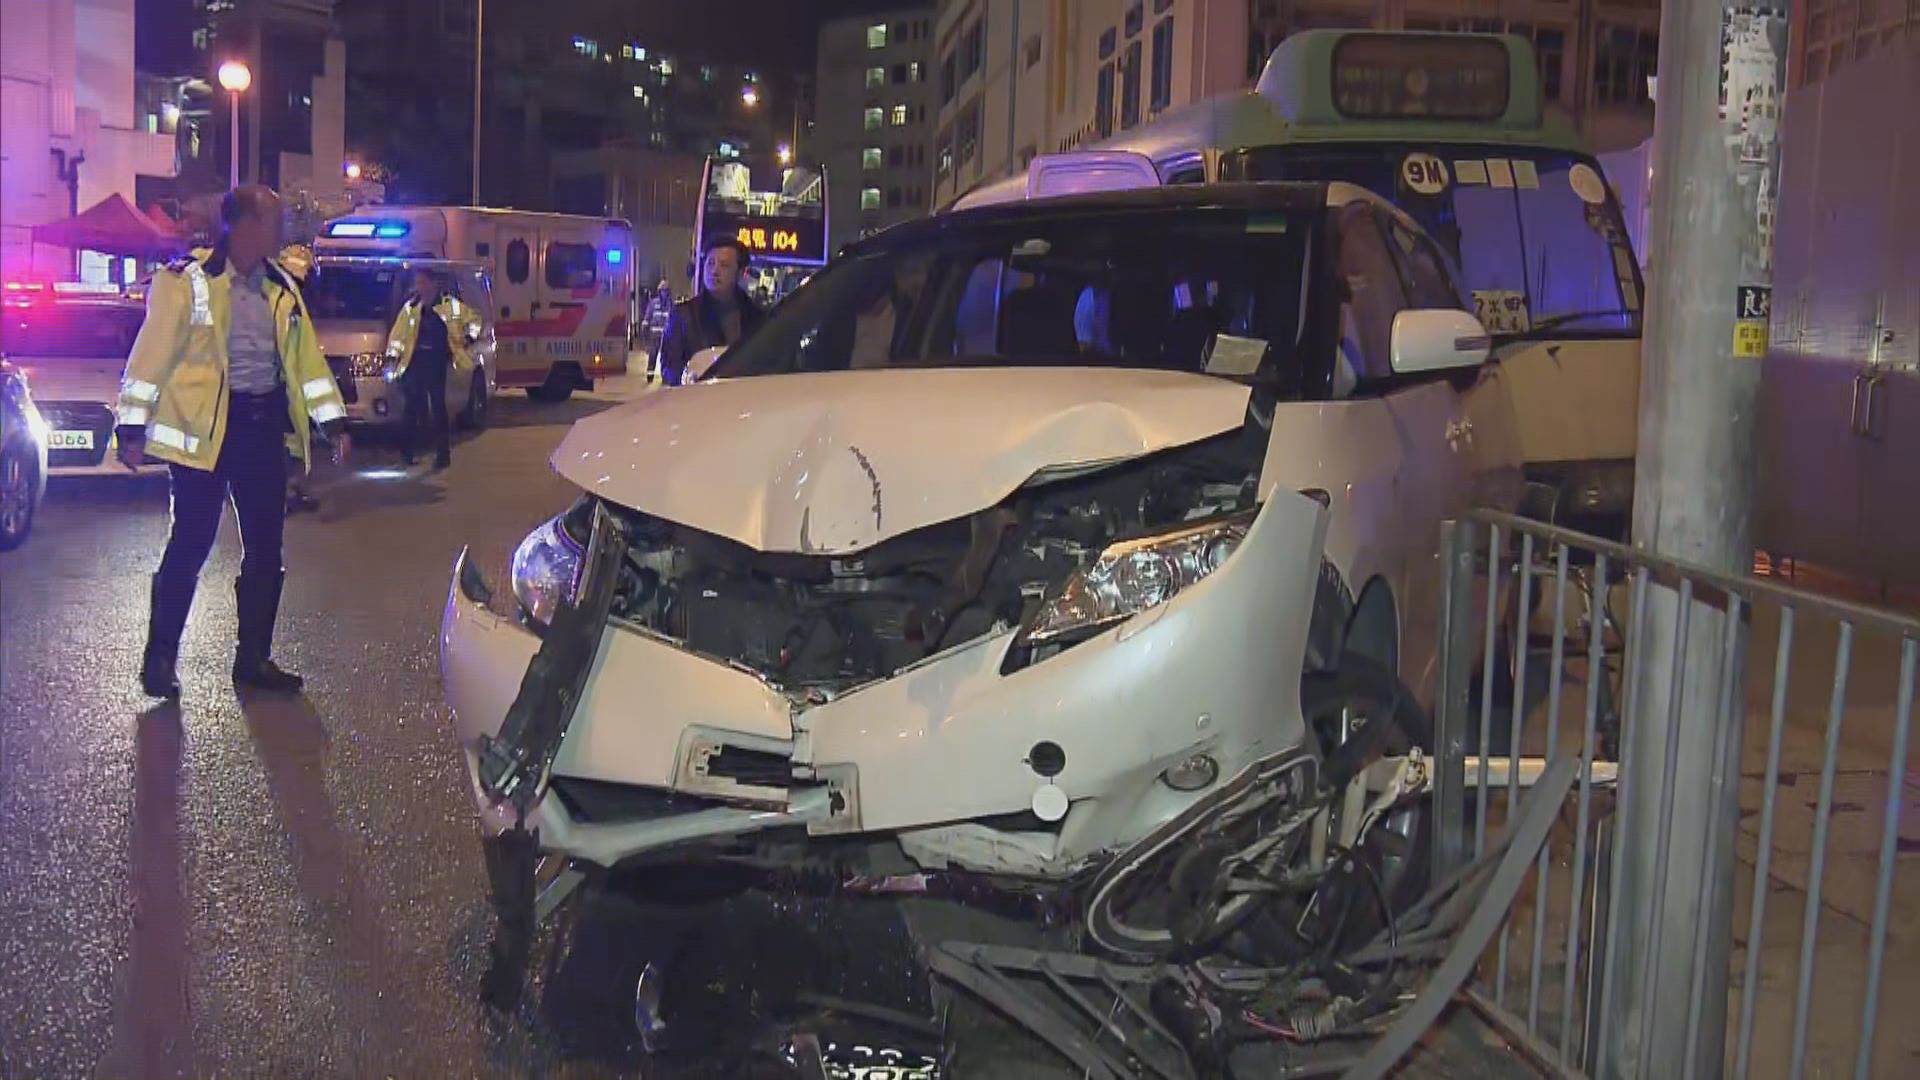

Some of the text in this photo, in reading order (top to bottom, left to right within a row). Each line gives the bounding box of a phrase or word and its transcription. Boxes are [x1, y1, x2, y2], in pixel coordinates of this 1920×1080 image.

[1407, 160, 1443, 184] 9M
[772, 230, 798, 251] 104
[545, 340, 619, 354] AMBULANCE
